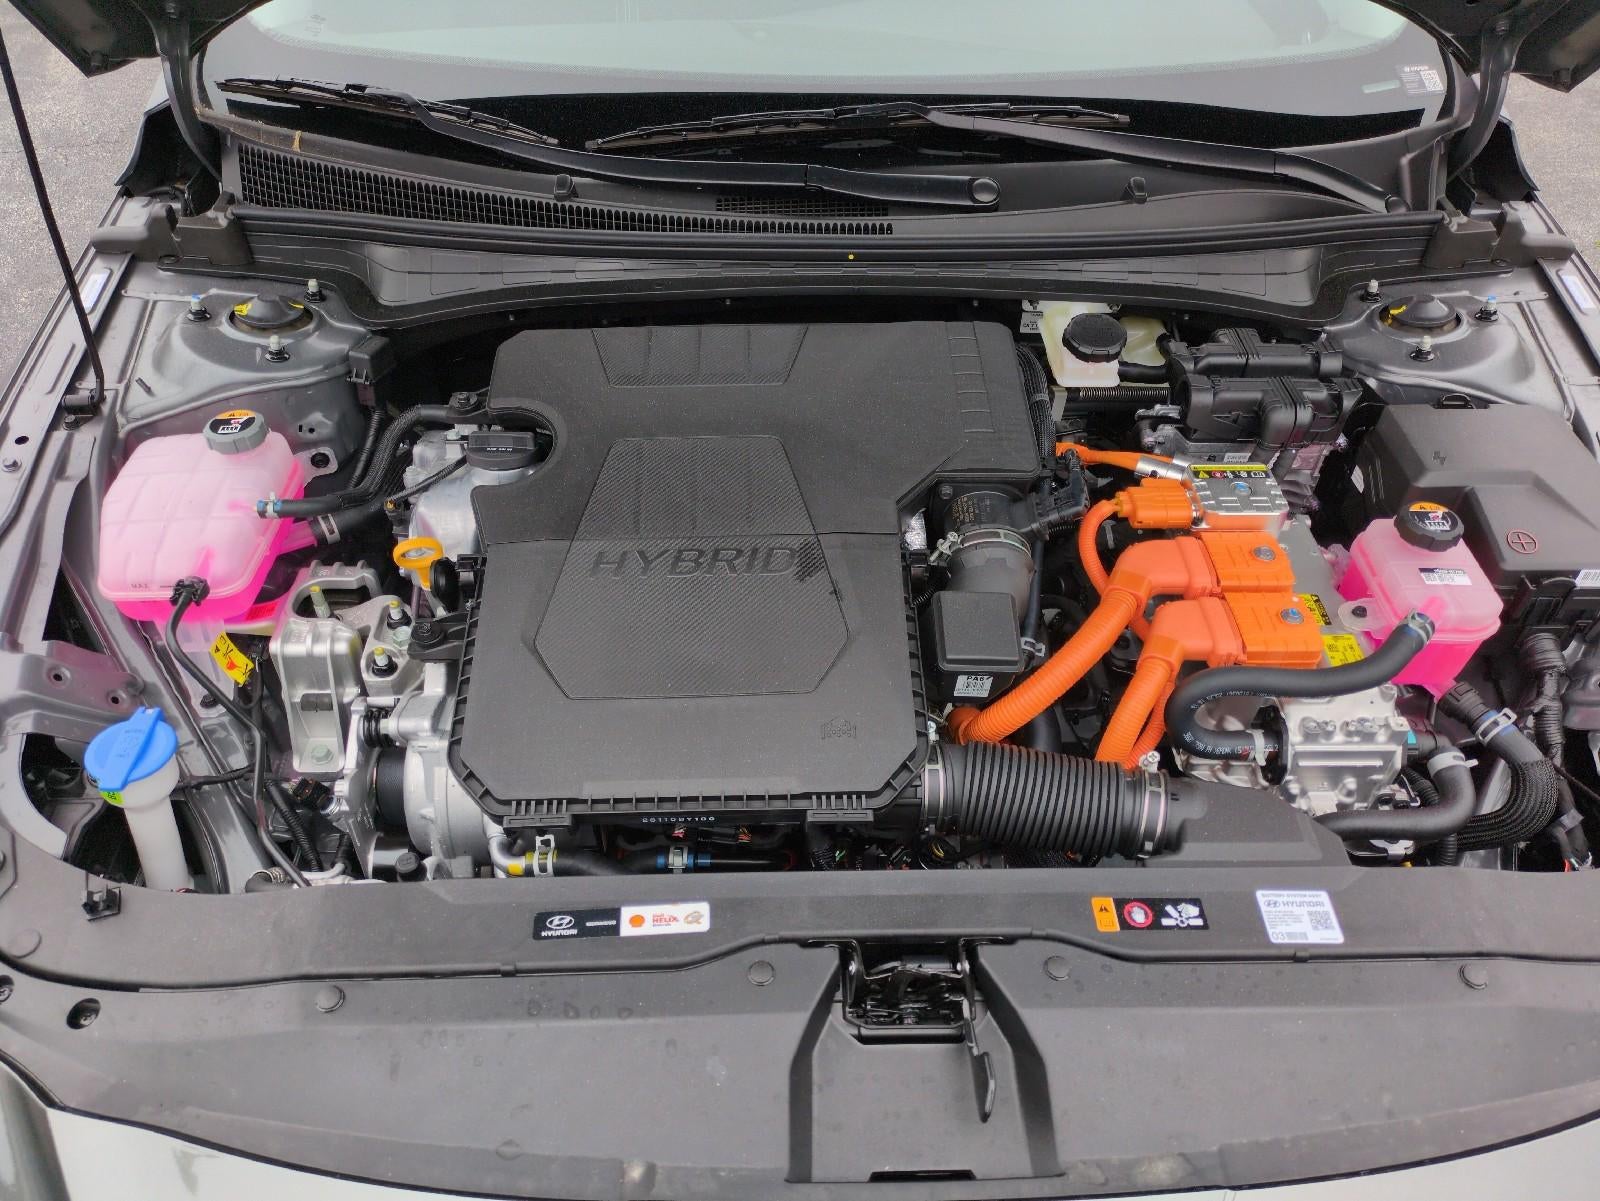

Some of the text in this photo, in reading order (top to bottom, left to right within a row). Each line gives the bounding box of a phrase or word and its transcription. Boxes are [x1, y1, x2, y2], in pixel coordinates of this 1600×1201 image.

[589, 548, 797, 580] HYBRID
[1281, 900, 1325, 908] HYUNDAI
[541, 929, 578, 937] HYUNDAI
